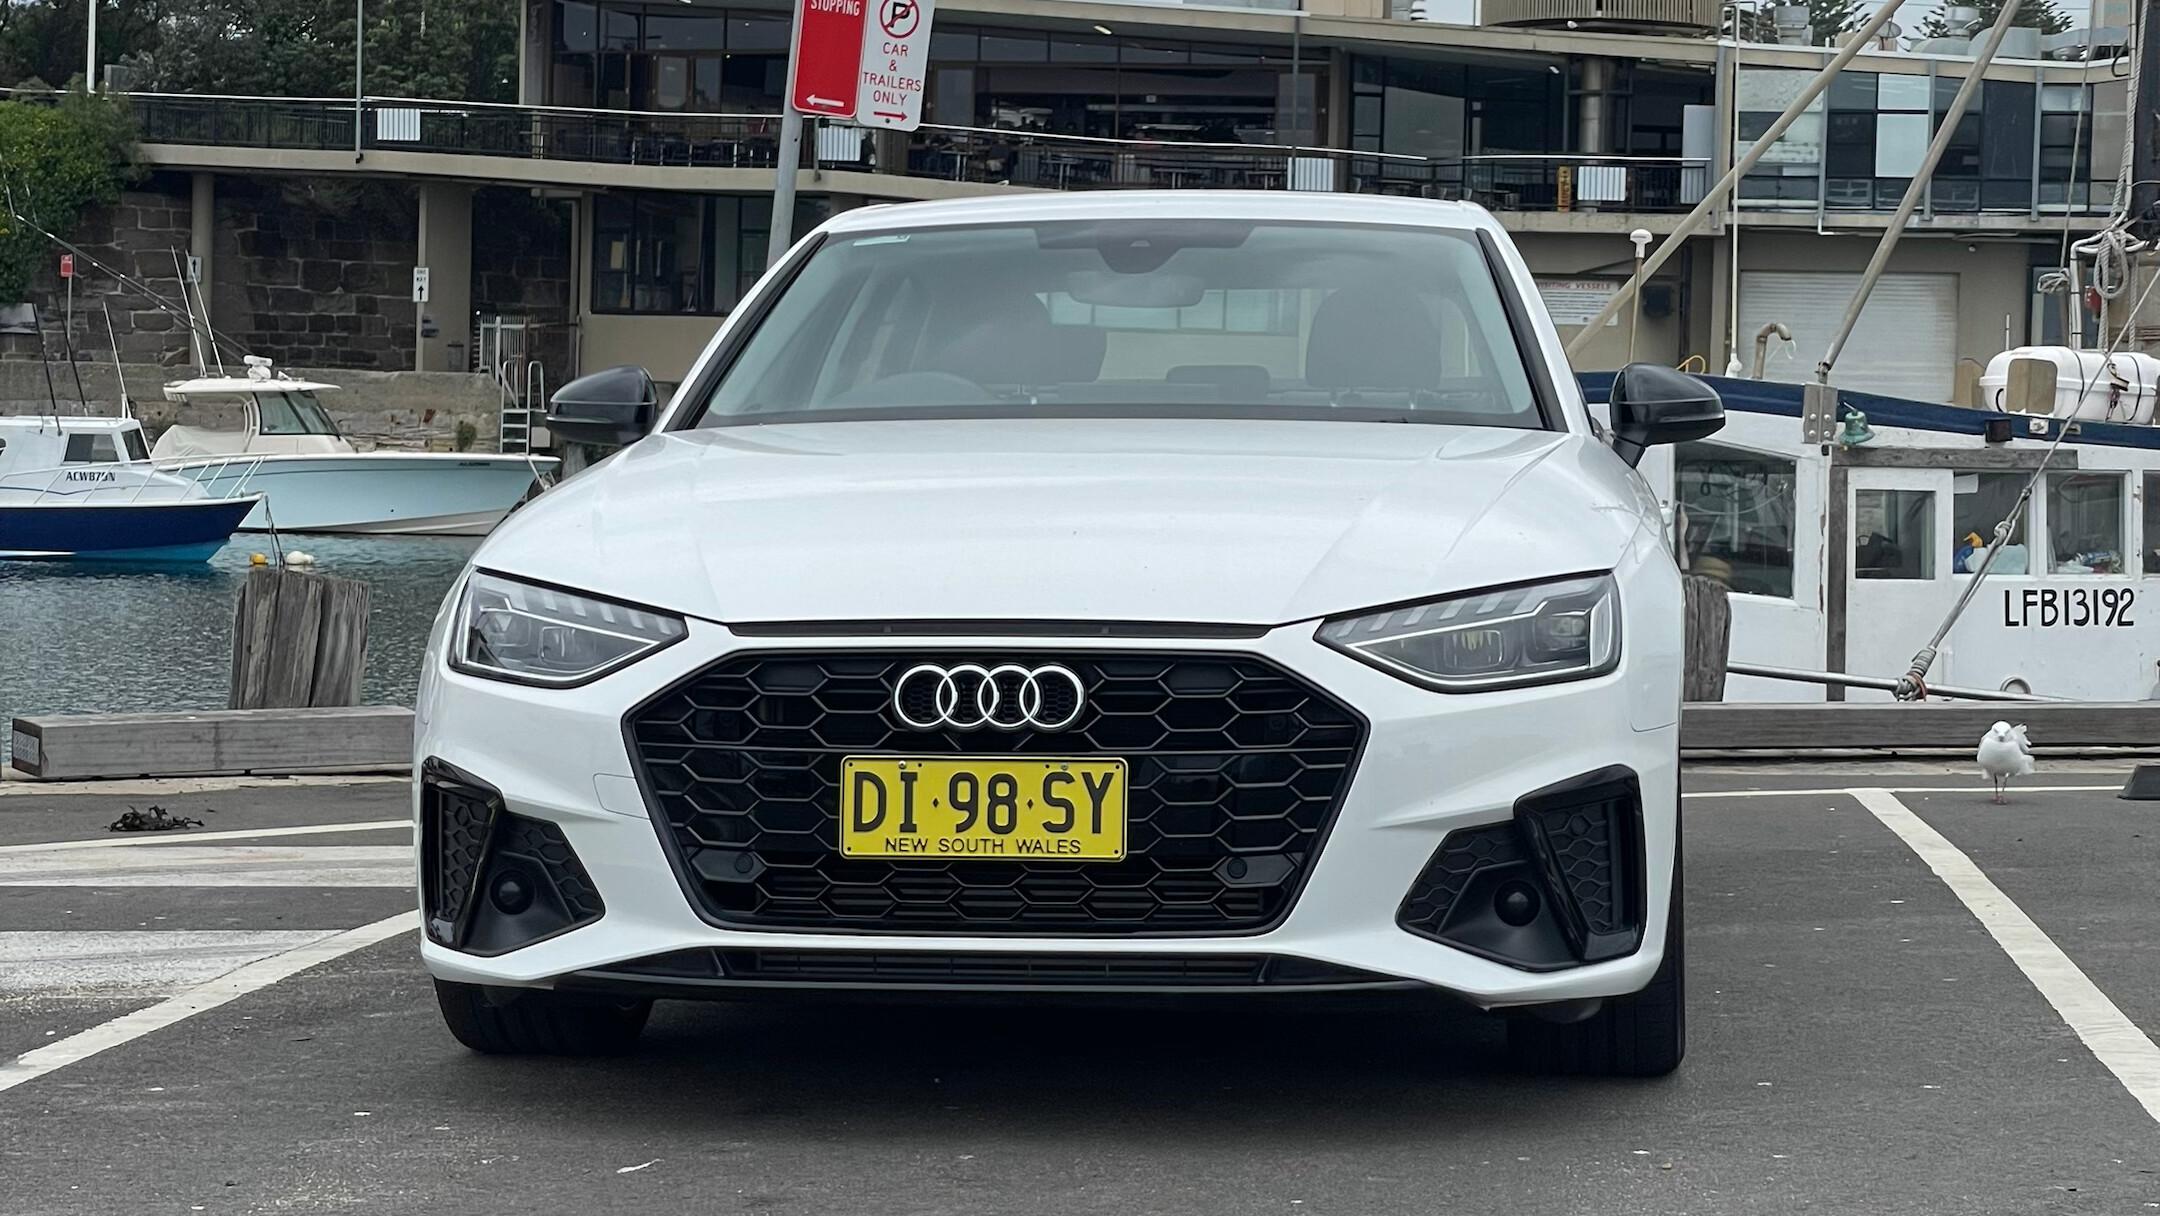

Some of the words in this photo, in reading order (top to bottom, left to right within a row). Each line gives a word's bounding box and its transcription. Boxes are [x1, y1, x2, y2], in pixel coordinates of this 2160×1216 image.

[882, 42, 909, 57] CAR
[888, 59, 897, 72] &
[863, 72, 922, 92] TRAILERS
[873, 90, 908, 106] ONLY
[2004, 588, 2135, 627] LFB13192
[885, 838, 928, 852] NEW
[938, 838, 1004, 853] SOUTH
[1015, 839, 1081, 854] WALES
